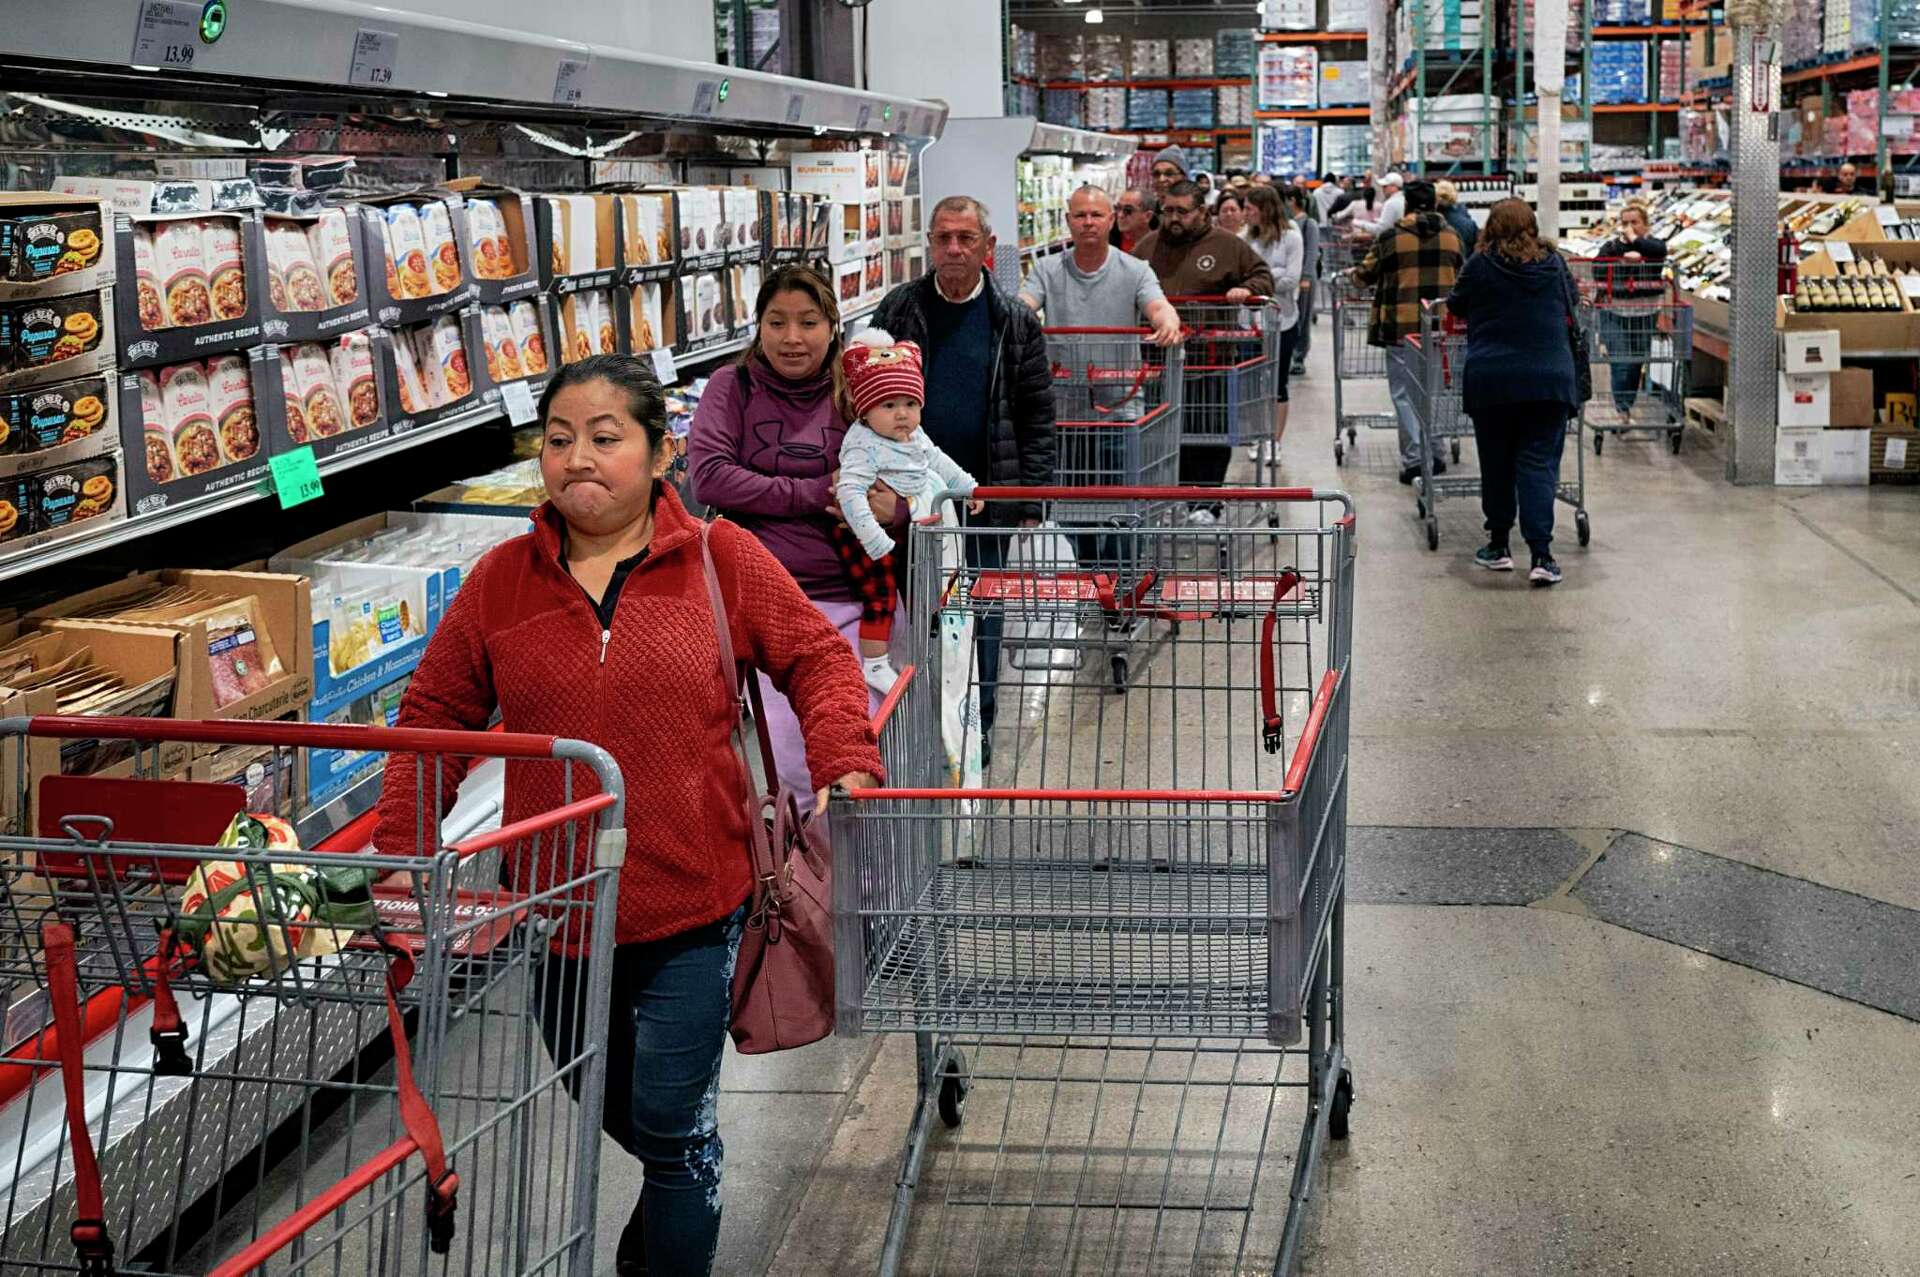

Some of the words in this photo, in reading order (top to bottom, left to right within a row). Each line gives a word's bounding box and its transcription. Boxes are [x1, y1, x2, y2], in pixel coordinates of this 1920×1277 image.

[164, 45, 194, 63] 13.99
[194, 331, 234, 346] AUTHENTIC
[235, 326, 260, 338] RECIPE
[205, 473, 246, 492] AUTHENTIC
[246, 464, 271, 479] RECIPE
